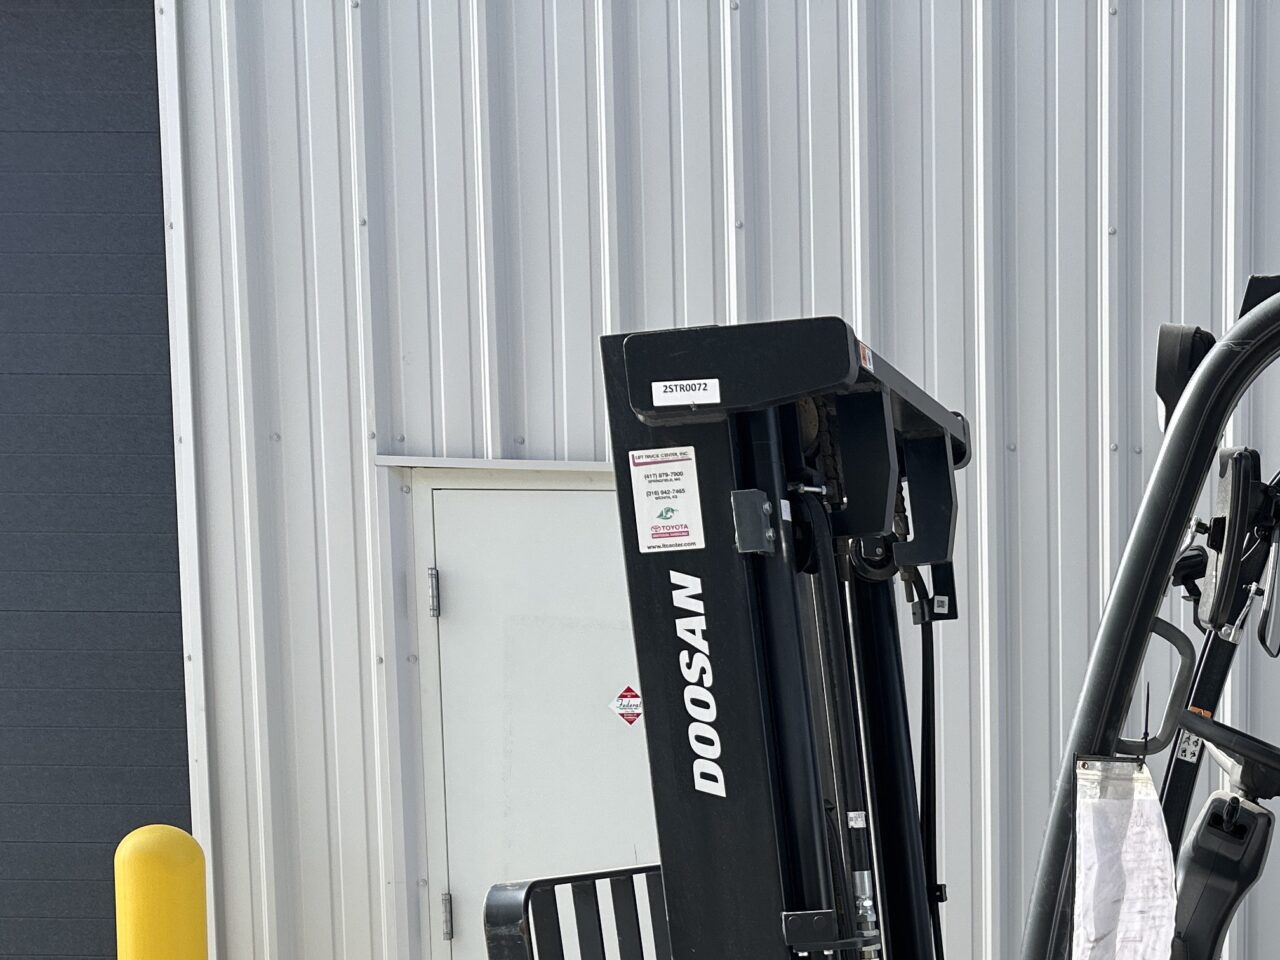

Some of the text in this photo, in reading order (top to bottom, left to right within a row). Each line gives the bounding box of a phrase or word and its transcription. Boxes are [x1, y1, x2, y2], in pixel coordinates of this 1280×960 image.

[662, 382, 708, 393] 2STR0072
[661, 523, 689, 531] TOYOTA
[669, 569, 727, 798] DOOSAN
[616, 698, 642, 709] Federal
